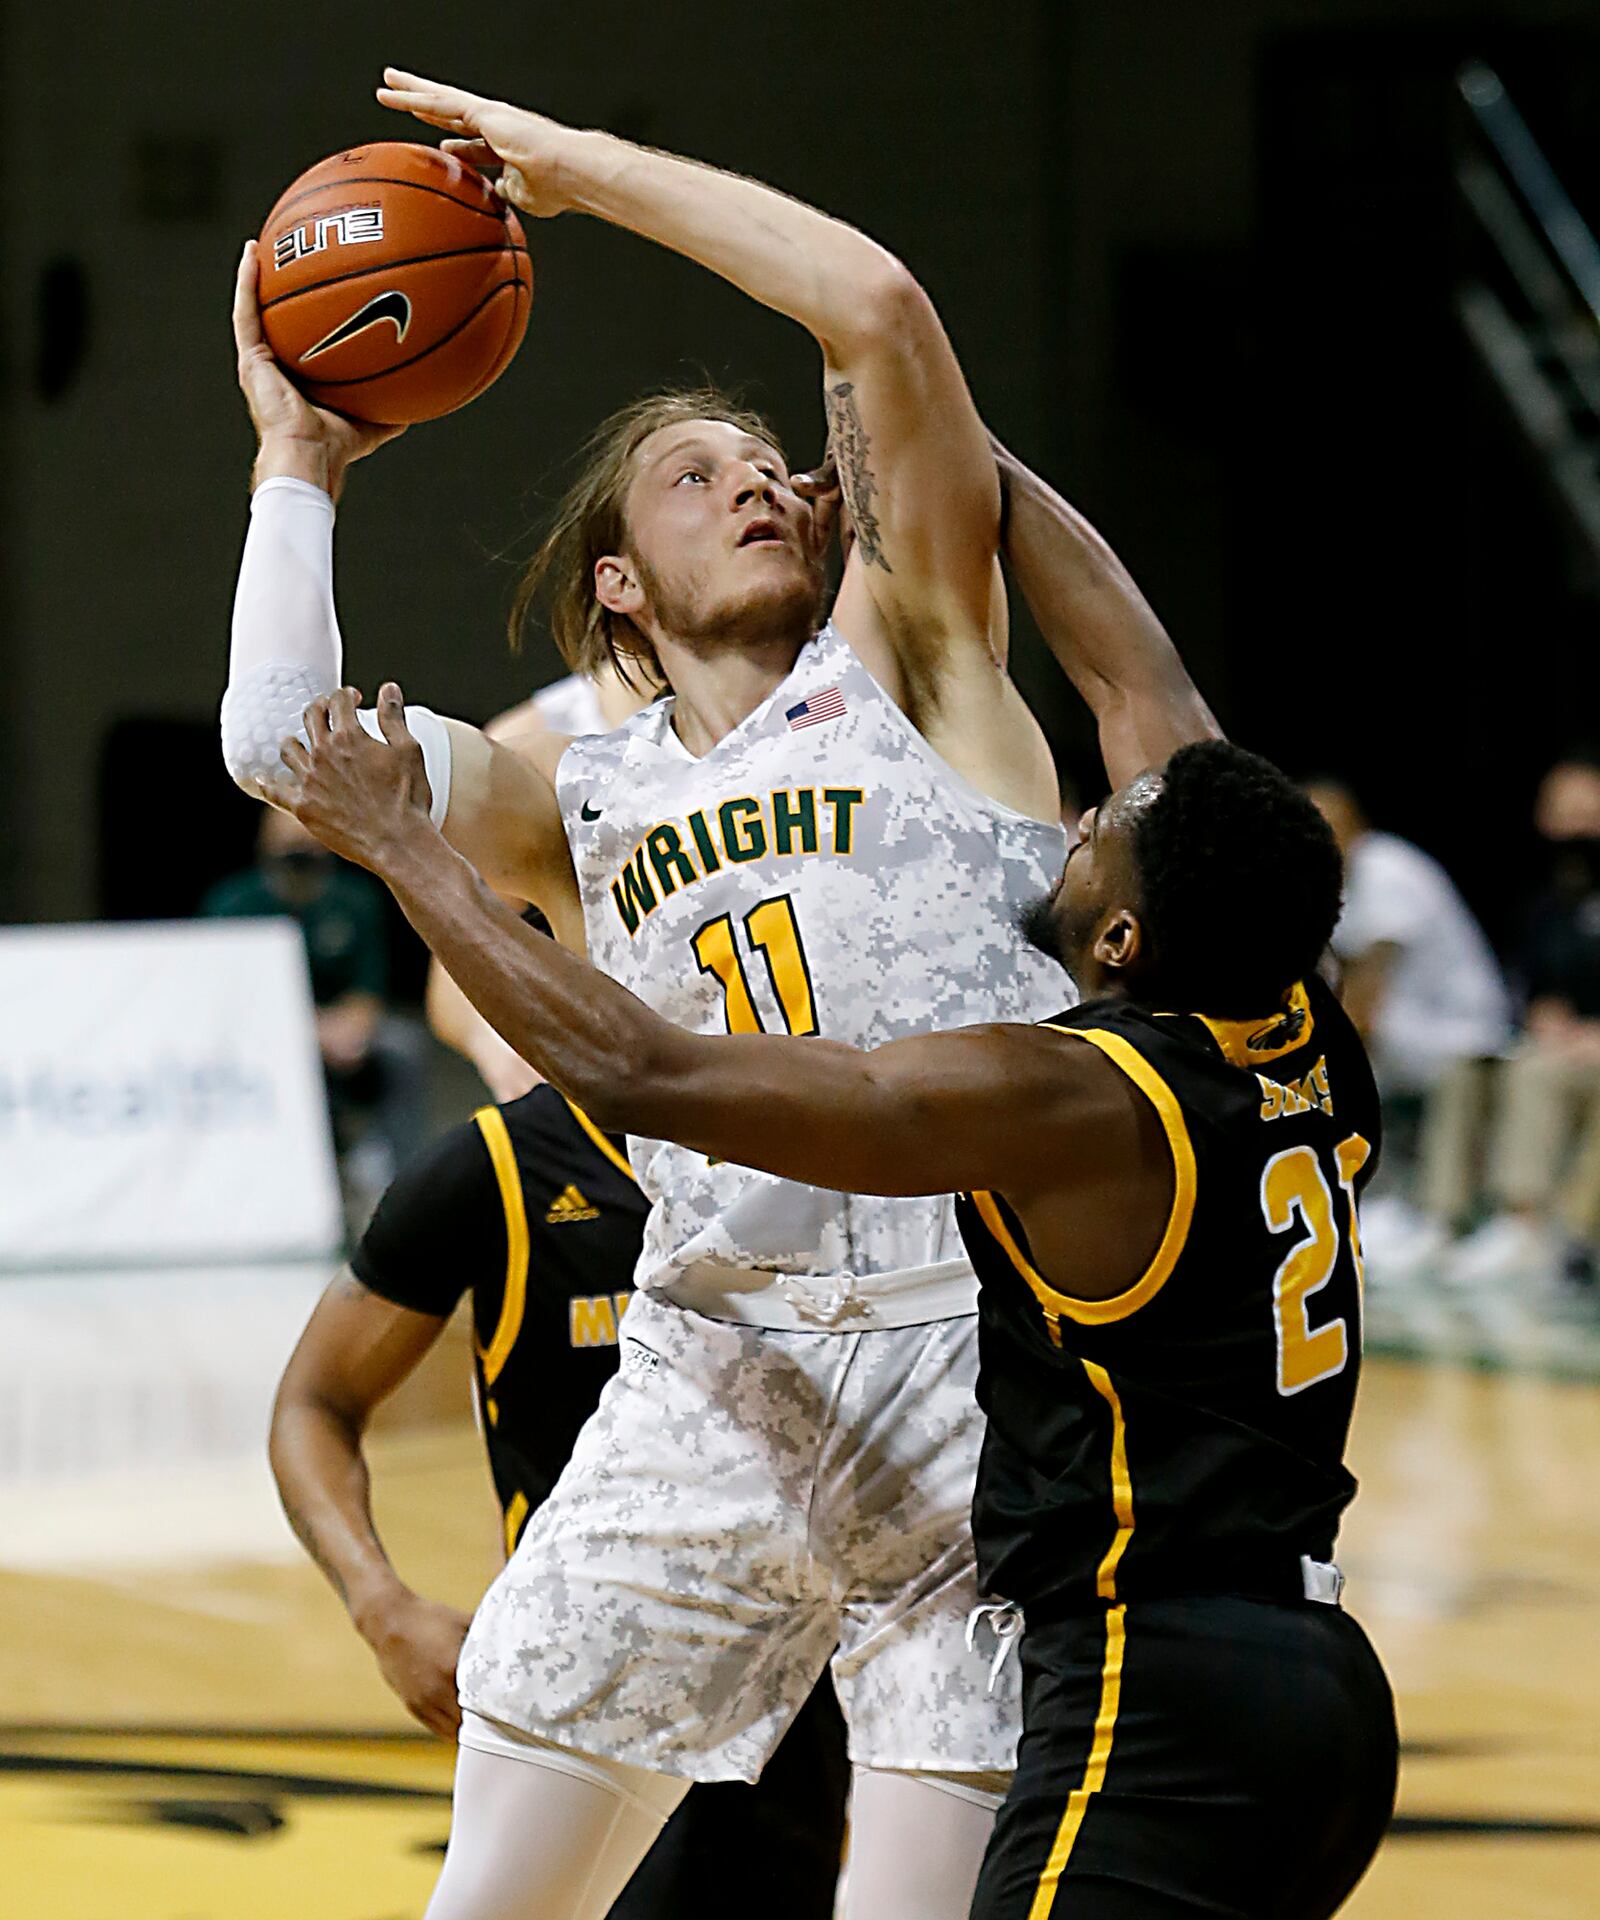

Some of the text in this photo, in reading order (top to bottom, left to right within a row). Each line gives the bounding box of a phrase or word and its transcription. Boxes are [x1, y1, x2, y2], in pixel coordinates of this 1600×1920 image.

[273, 208, 384, 271] ELITE
[610, 786, 865, 939] WRIGHT
[689, 892, 820, 1037] 11
